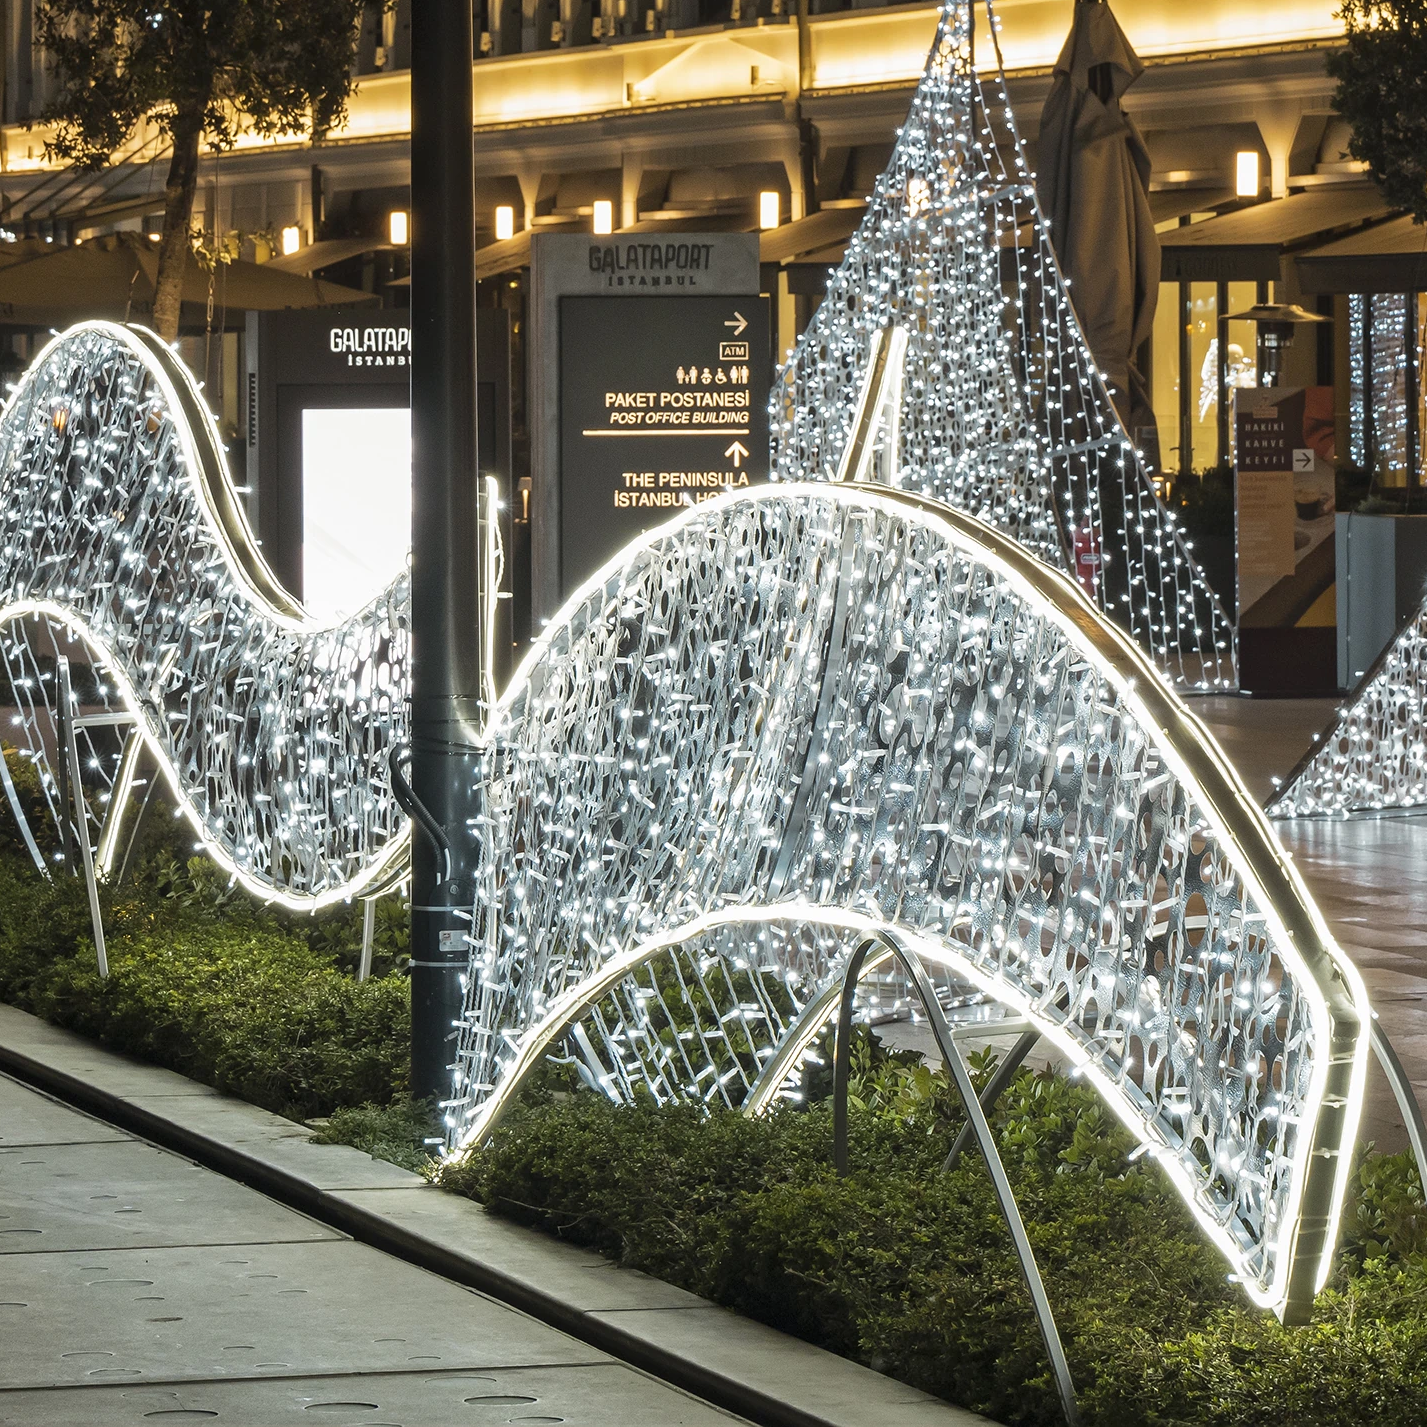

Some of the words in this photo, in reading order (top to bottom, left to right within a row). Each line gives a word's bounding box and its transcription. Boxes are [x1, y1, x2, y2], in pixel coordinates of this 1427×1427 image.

[588, 244, 715, 274] GALATAPORT
[724, 346, 745, 356] ATM
[605, 392, 657, 408] PAKET
[660, 389, 750, 407] POSTANESİ
[610, 411, 645, 424] POST
[645, 411, 691, 424] OFFICE
[692, 411, 750, 424] BUILDING
[1245, 438, 1285, 448] KAHVE
[622, 472, 656, 487] THE
[659, 471, 750, 487] PENINSULA
